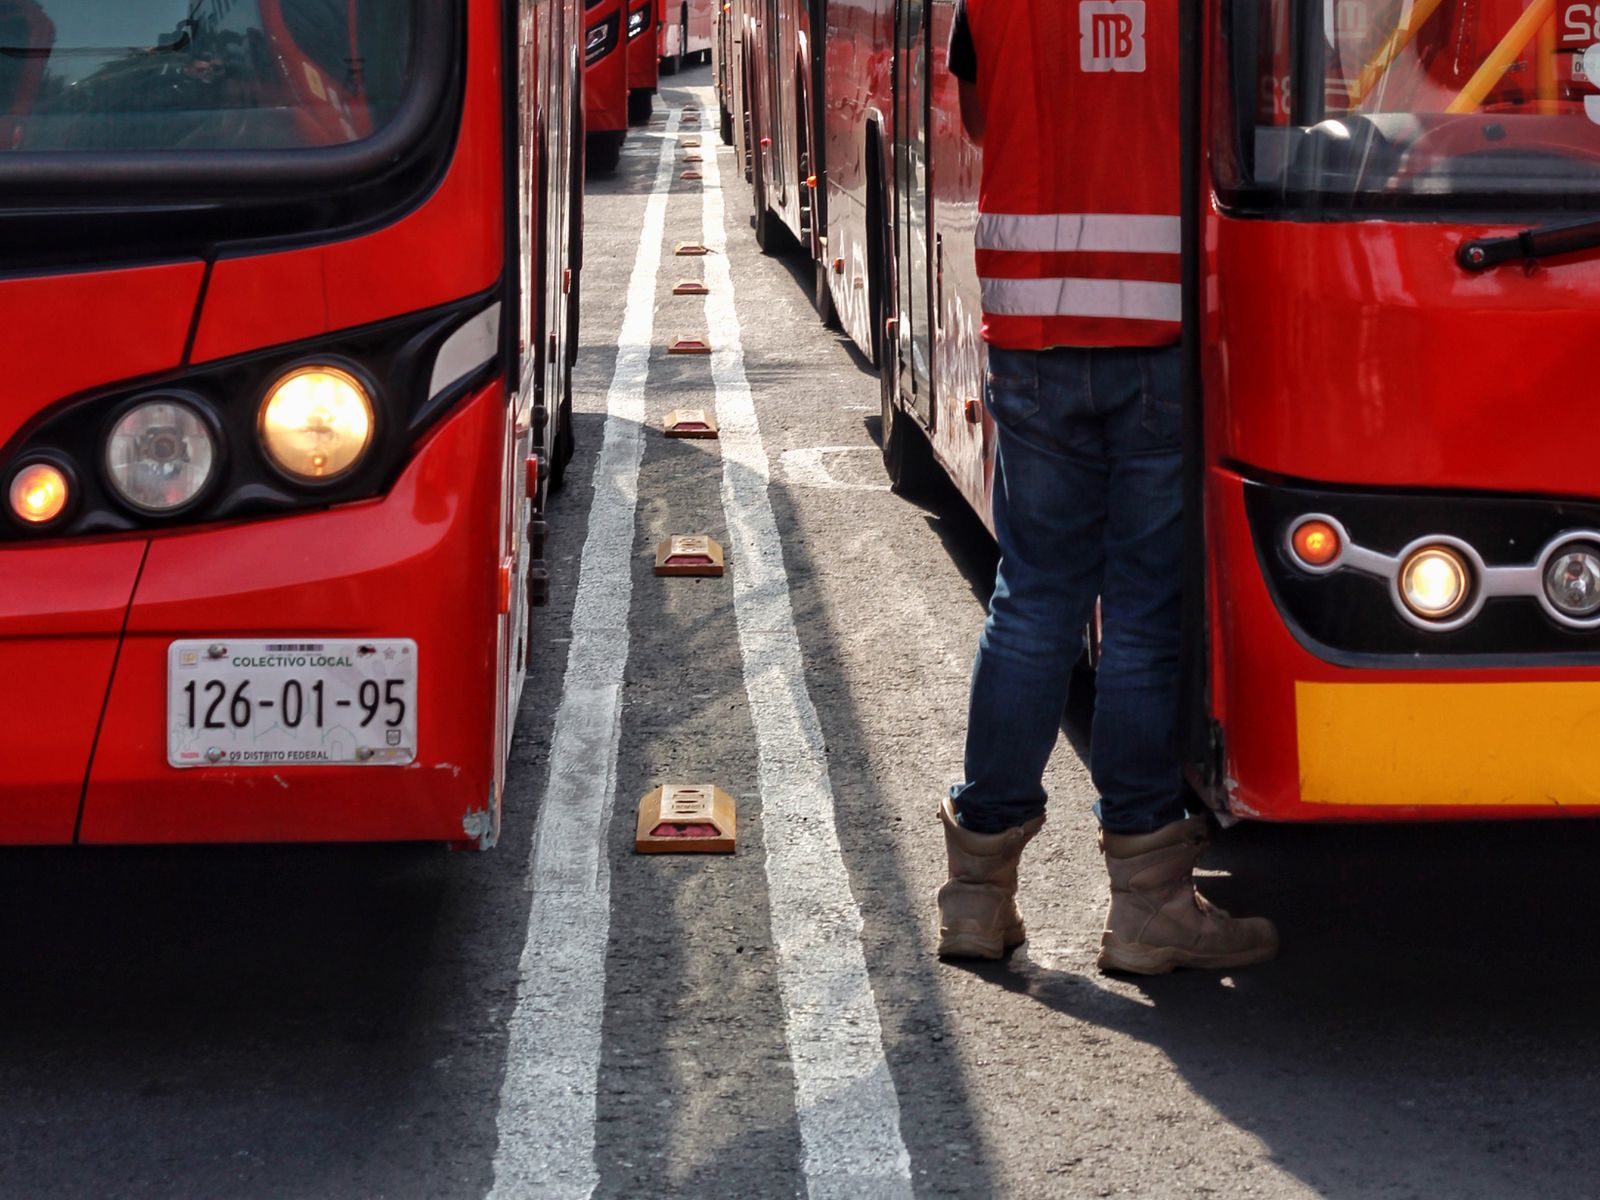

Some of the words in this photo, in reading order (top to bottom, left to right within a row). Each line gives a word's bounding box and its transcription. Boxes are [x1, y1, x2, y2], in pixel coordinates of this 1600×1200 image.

[232, 656, 306, 667] COLECTIVO
[310, 656, 353, 667] LOCAL
[184, 679, 406, 728] 126-01-95
[229, 751, 241, 760] 09
[243, 751, 285, 760] DISTRITO
[287, 751, 329, 760] FEDERAL
